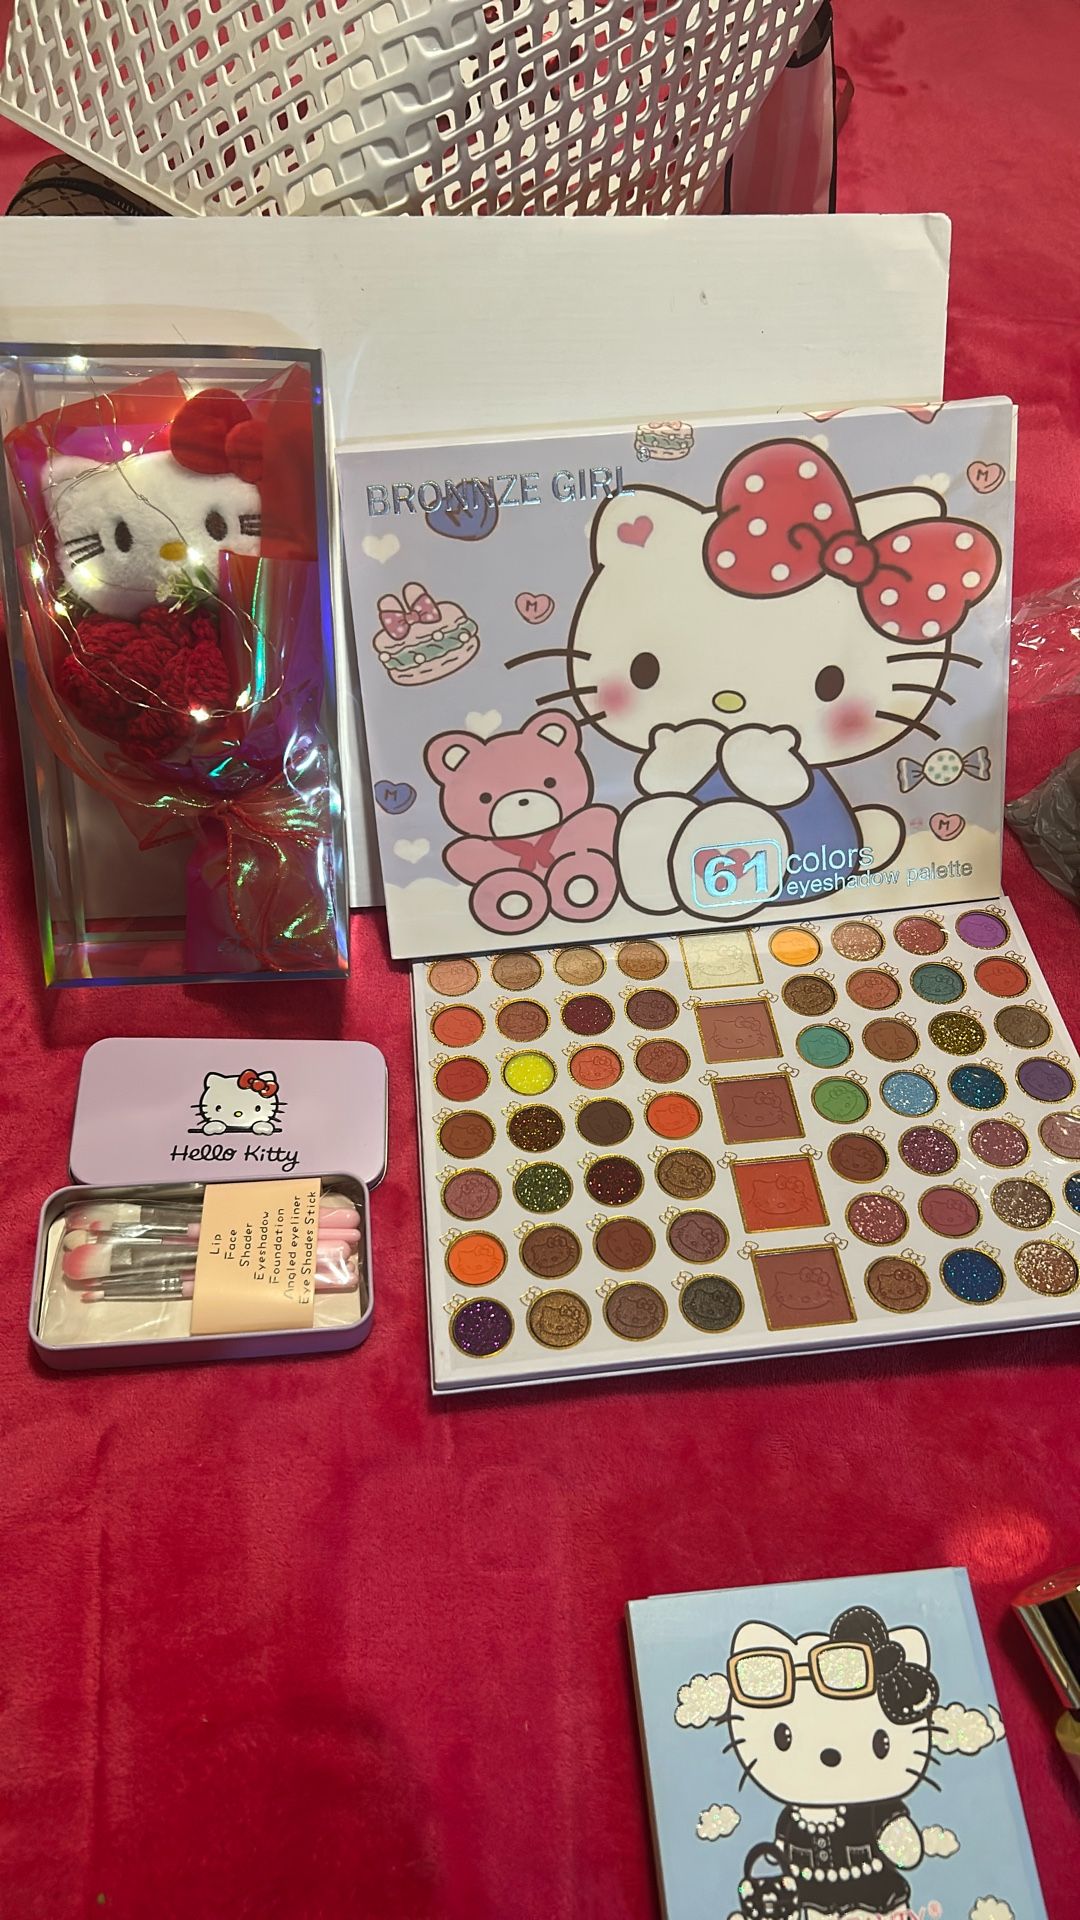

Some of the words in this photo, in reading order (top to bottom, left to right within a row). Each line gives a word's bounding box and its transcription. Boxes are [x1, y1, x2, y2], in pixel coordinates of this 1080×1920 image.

[366, 472, 541, 517] BRONNZE
[552, 466, 636, 503] GIRL
[976, 469, 989, 482] M
[525, 600, 538, 612] M
[384, 789, 397, 801] M
[938, 819, 950, 831] M
[703, 851, 769, 897] 61
[786, 844, 874, 875] colors
[786, 869, 900, 899] eyeshadow
[906, 860, 973, 887] palette
[170, 1144, 237, 1161] Hello
[244, 1145, 300, 1172] Kitty
[304, 1191, 316, 1225] Stick
[209, 1234, 222, 1255] Lip
[224, 1229, 238, 1260] Face
[240, 1223, 253, 1267] Shader
[254, 1211, 270, 1280] Eyeshadow
[269, 1208, 285, 1284] Foundation
[284, 1251, 297, 1300] Angled
[291, 1195, 301, 1248] eyeliner
[301, 1230, 314, 1275] Shades
[299, 1279, 311, 1305] Eye
